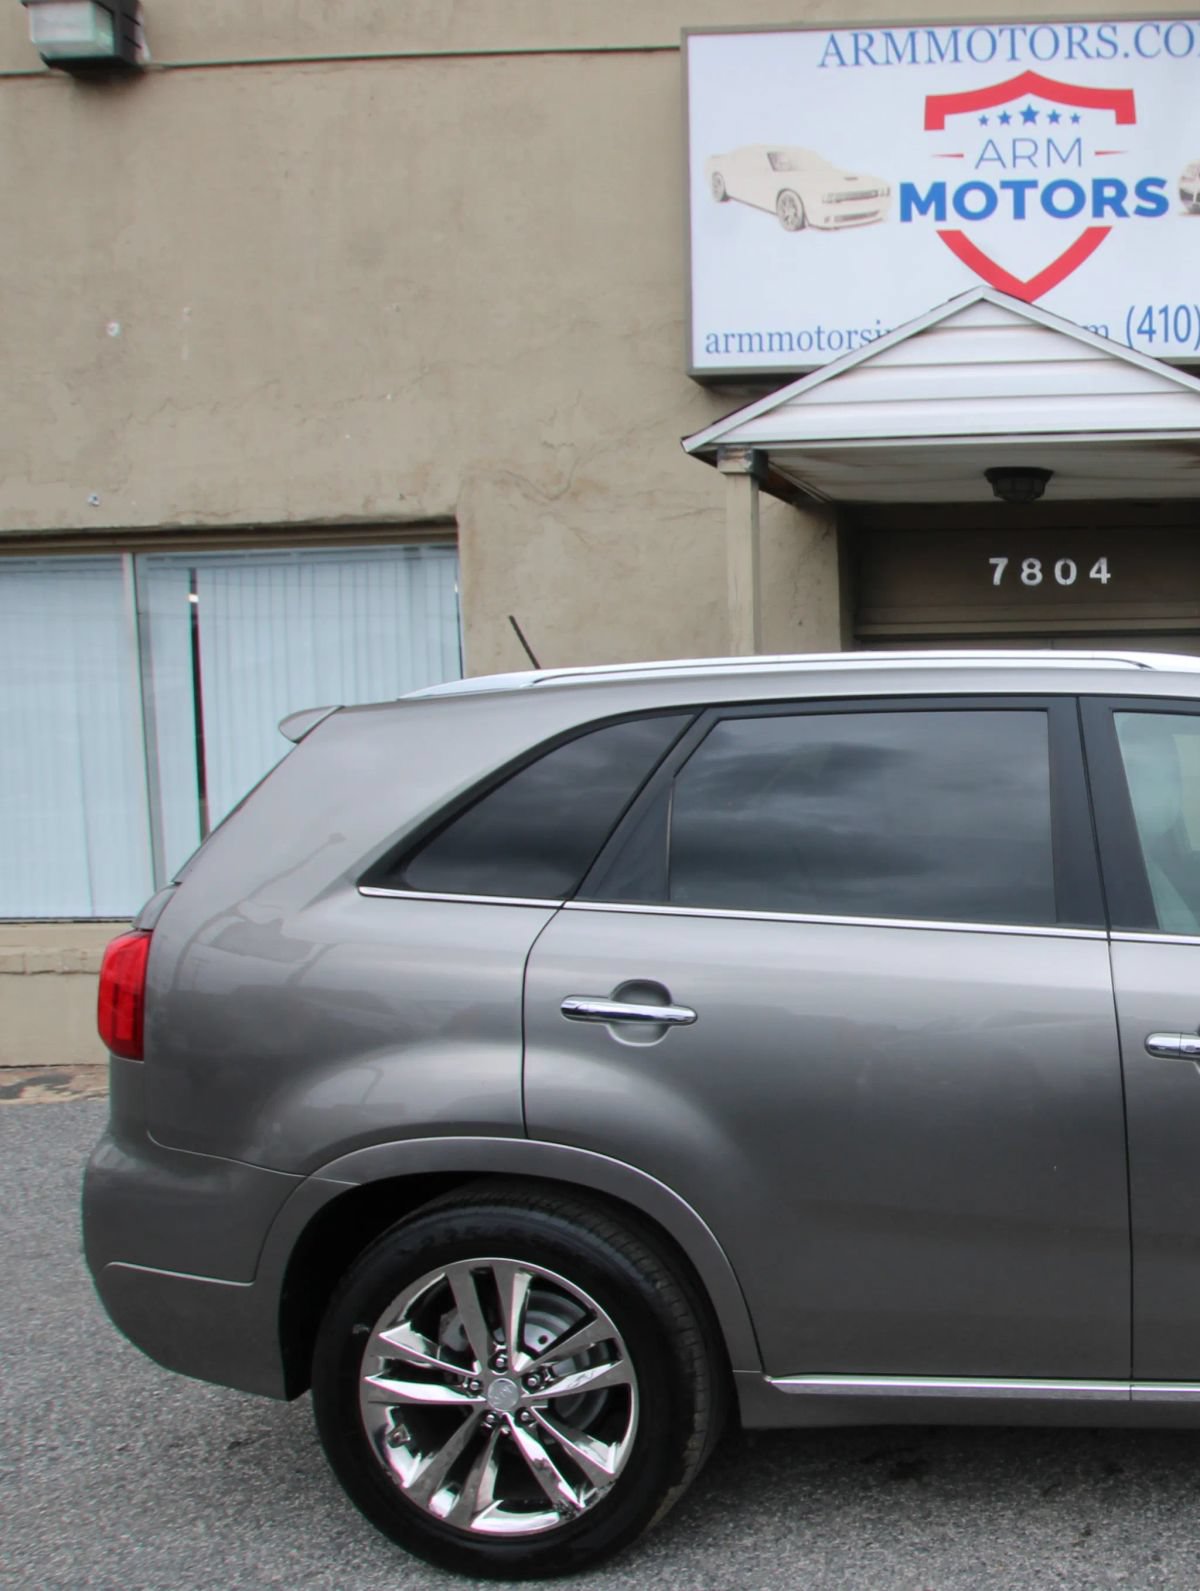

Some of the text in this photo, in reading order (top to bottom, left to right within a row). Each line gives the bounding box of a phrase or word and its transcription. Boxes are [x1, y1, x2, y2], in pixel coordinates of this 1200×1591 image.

[975, 136, 1084, 168] ARM
[898, 176, 1170, 223] MOTORS
[988, 557, 1112, 586] 7804
